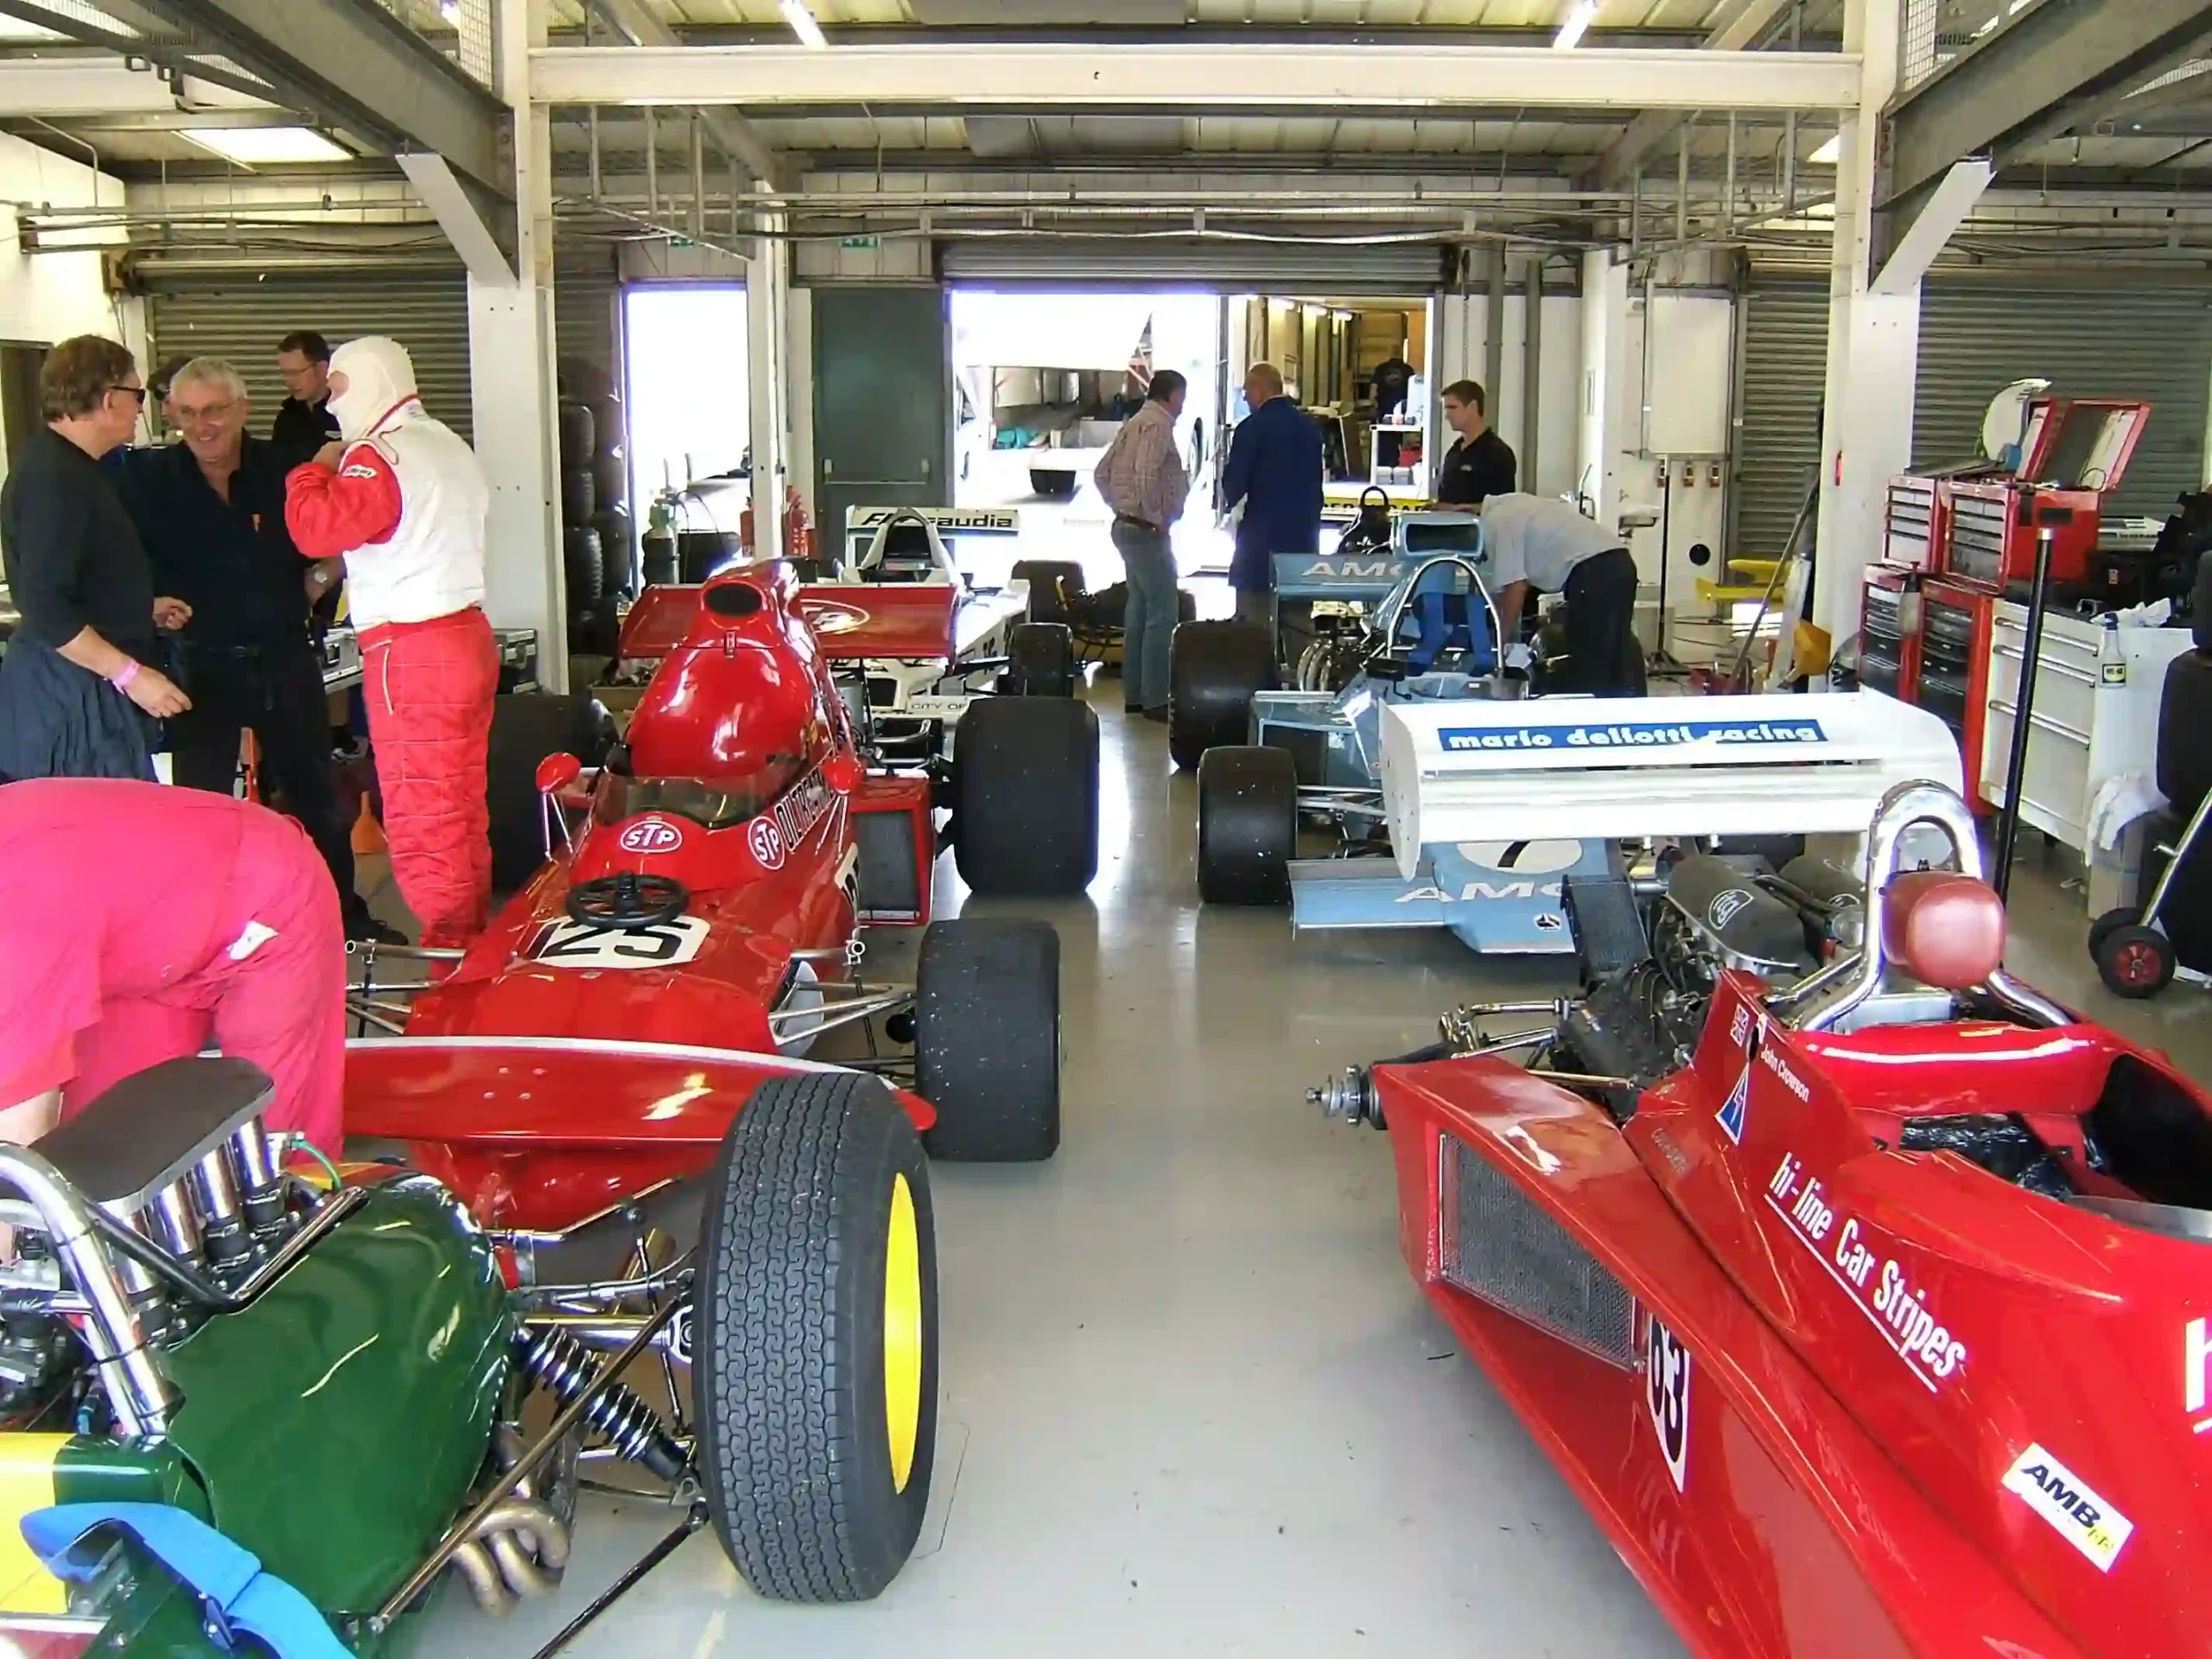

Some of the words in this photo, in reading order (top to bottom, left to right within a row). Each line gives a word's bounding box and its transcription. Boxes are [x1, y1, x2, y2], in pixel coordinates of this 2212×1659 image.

[1448, 729, 1553, 749] mario
[1707, 723, 1819, 742] racing
[626, 823, 675, 847] STP
[755, 823, 779, 861] STP
[1760, 1043, 1778, 1072] John
[1769, 1151, 1834, 1240] hi-line
[1834, 1217, 1876, 1287] Car
[1873, 1259, 1967, 1376] Stripes
[2020, 1464, 2101, 1529] AMB
